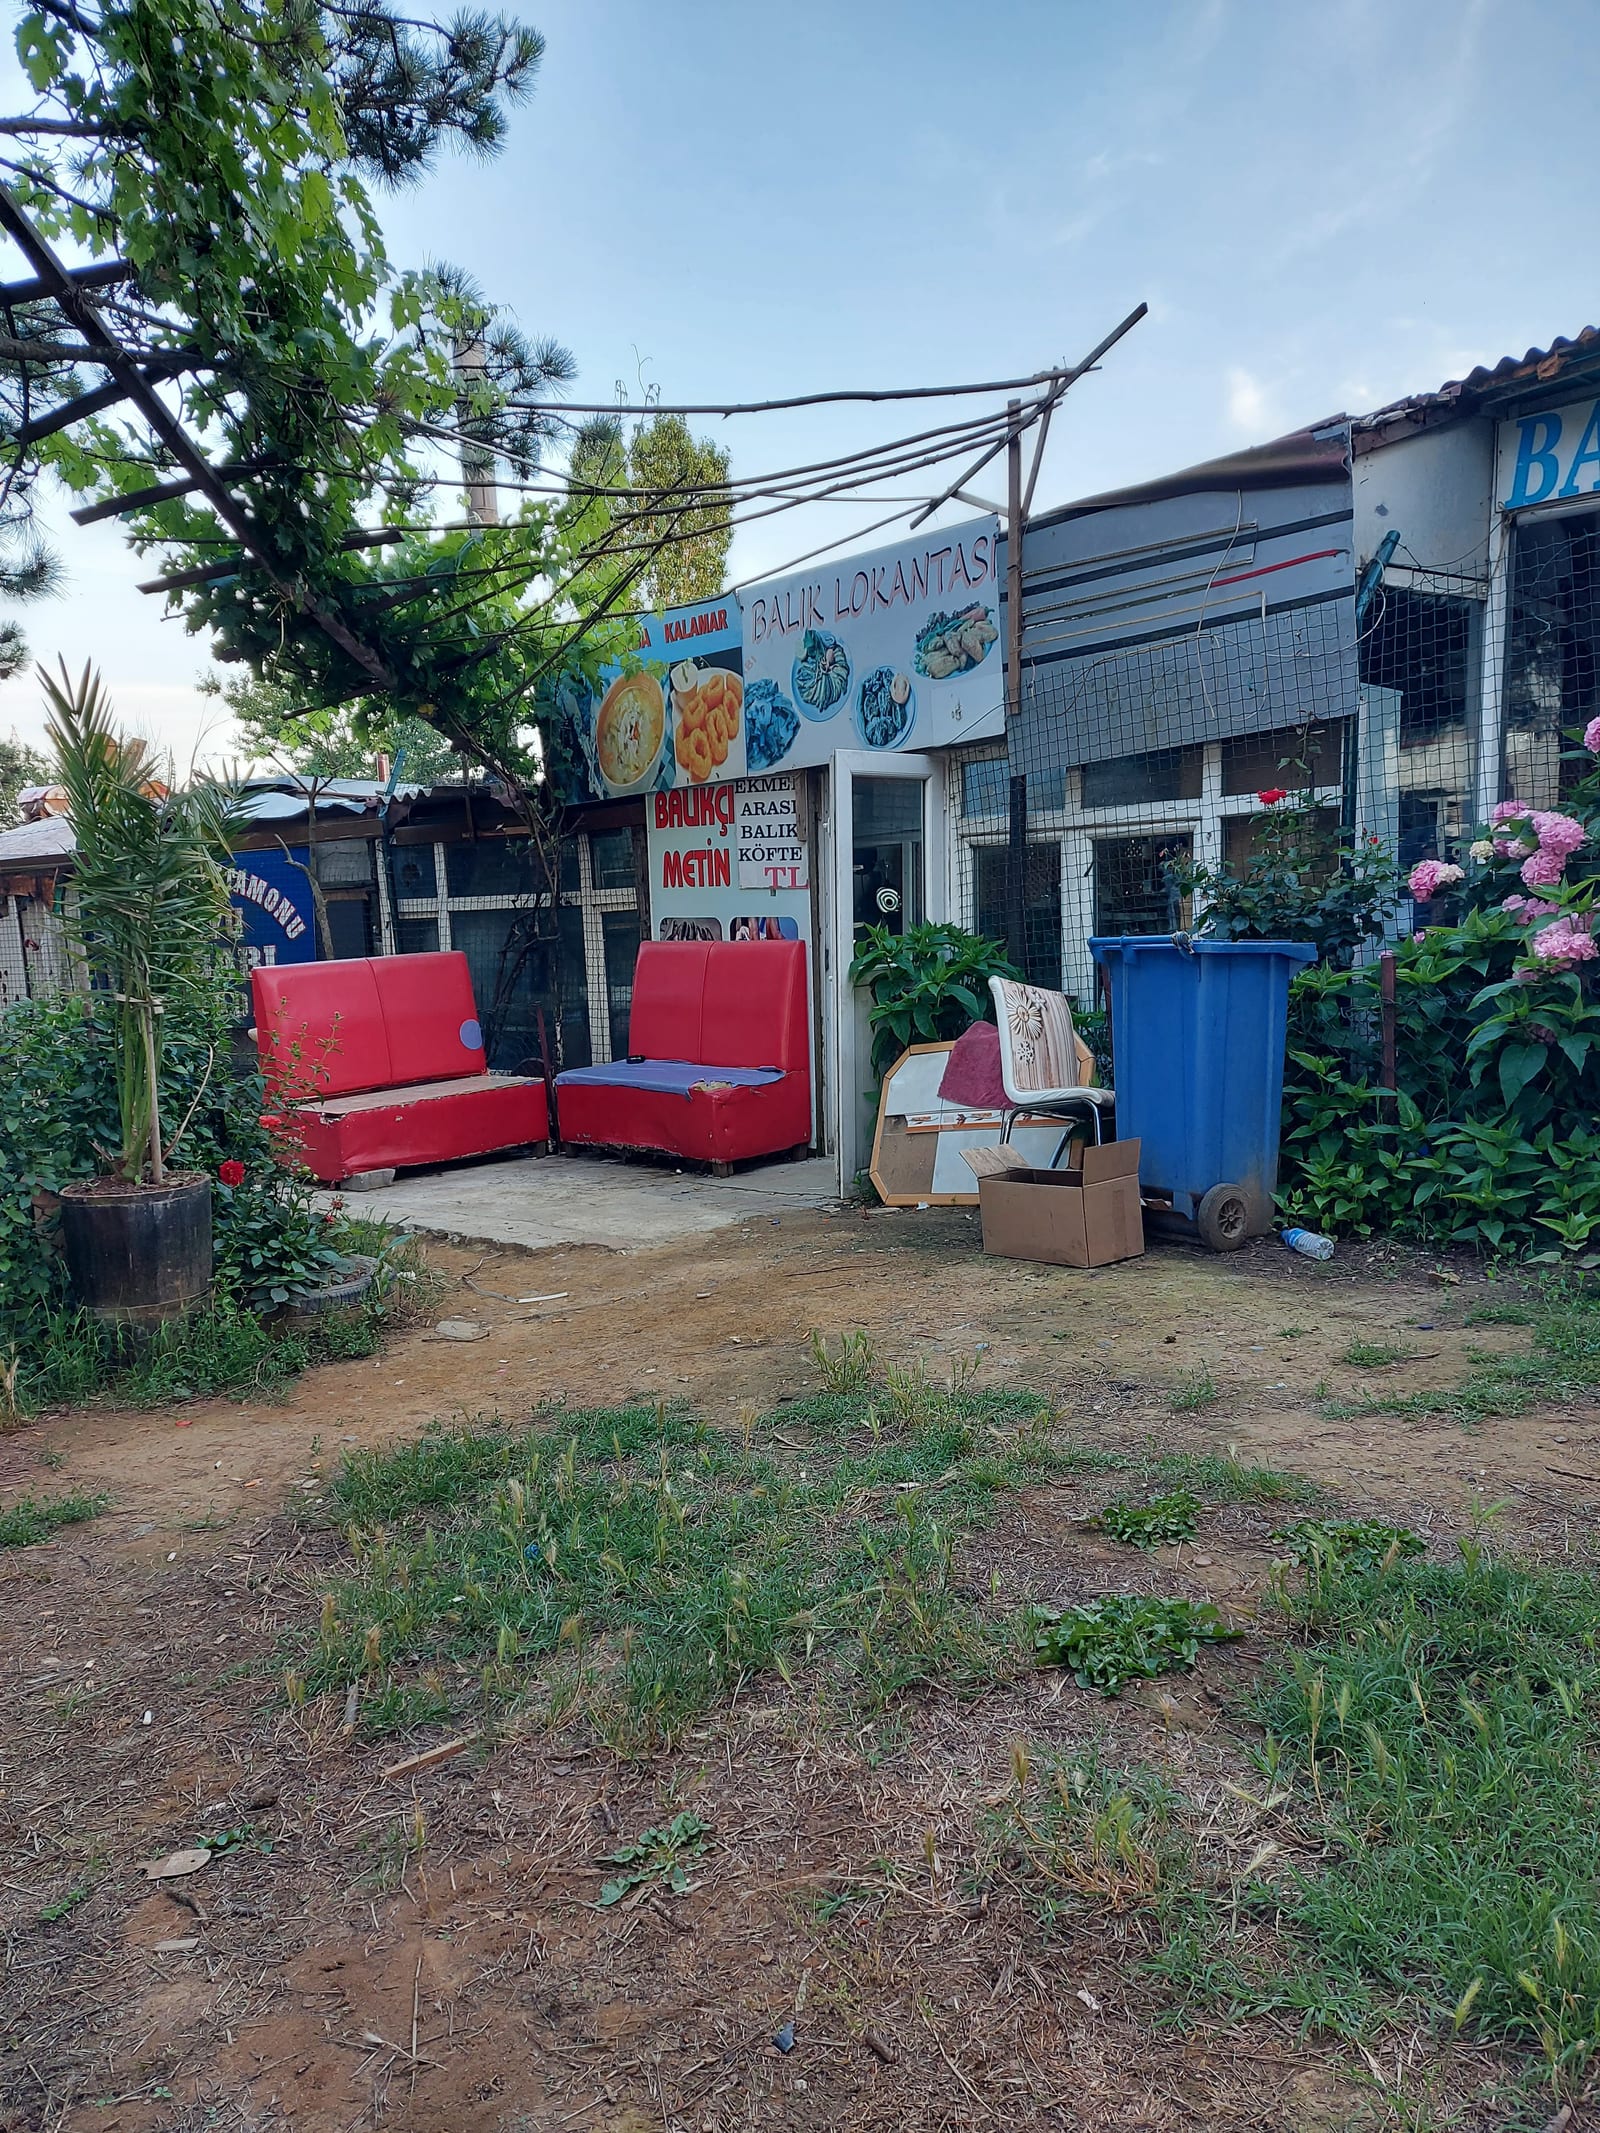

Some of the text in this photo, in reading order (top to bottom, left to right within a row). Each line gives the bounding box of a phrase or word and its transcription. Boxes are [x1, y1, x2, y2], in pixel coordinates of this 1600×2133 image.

[751, 534, 996, 644] BALIK LOKANTASI
[664, 609, 729, 644] KALAMAR
[654, 784, 735, 837] BALIKÇI
[740, 799, 796, 816] ARASI
[741, 823, 798, 839] BALIK
[663, 837, 731, 888] METİN
[738, 843, 802, 862] KÖFTE
[764, 866, 809, 889] TL
